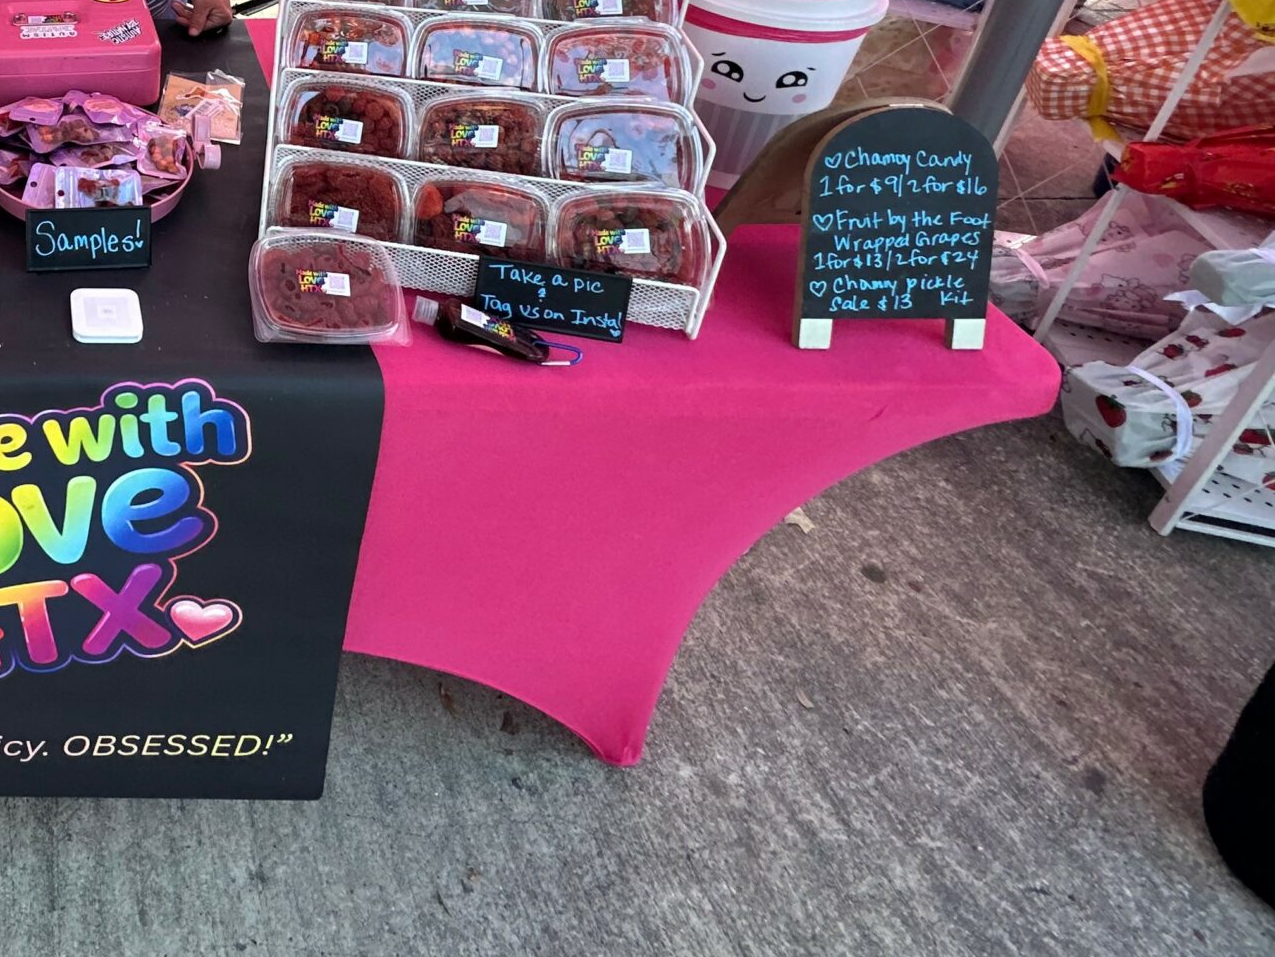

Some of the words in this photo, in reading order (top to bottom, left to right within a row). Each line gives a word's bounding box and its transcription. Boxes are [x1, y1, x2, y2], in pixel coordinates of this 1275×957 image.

[916, 150, 972, 175] Candy
[956, 176, 988, 195] $16
[836, 209, 883, 230] Fruit
[887, 209, 906, 233] by
[911, 210, 944, 228] the
[950, 212, 992, 229] Foot
[36, 219, 144, 259] Samples!
[834, 234, 909, 252] Wrapped
[915, 230, 980, 247] Grapes
[489, 264, 545, 286] Take
[551, 274, 568, 287] a
[906, 274, 966, 294] pickle
[481, 294, 513, 319] Tag
[543, 309, 565, 321] on
[877, 295, 913, 312] $13
[42, 390, 237, 466] with
